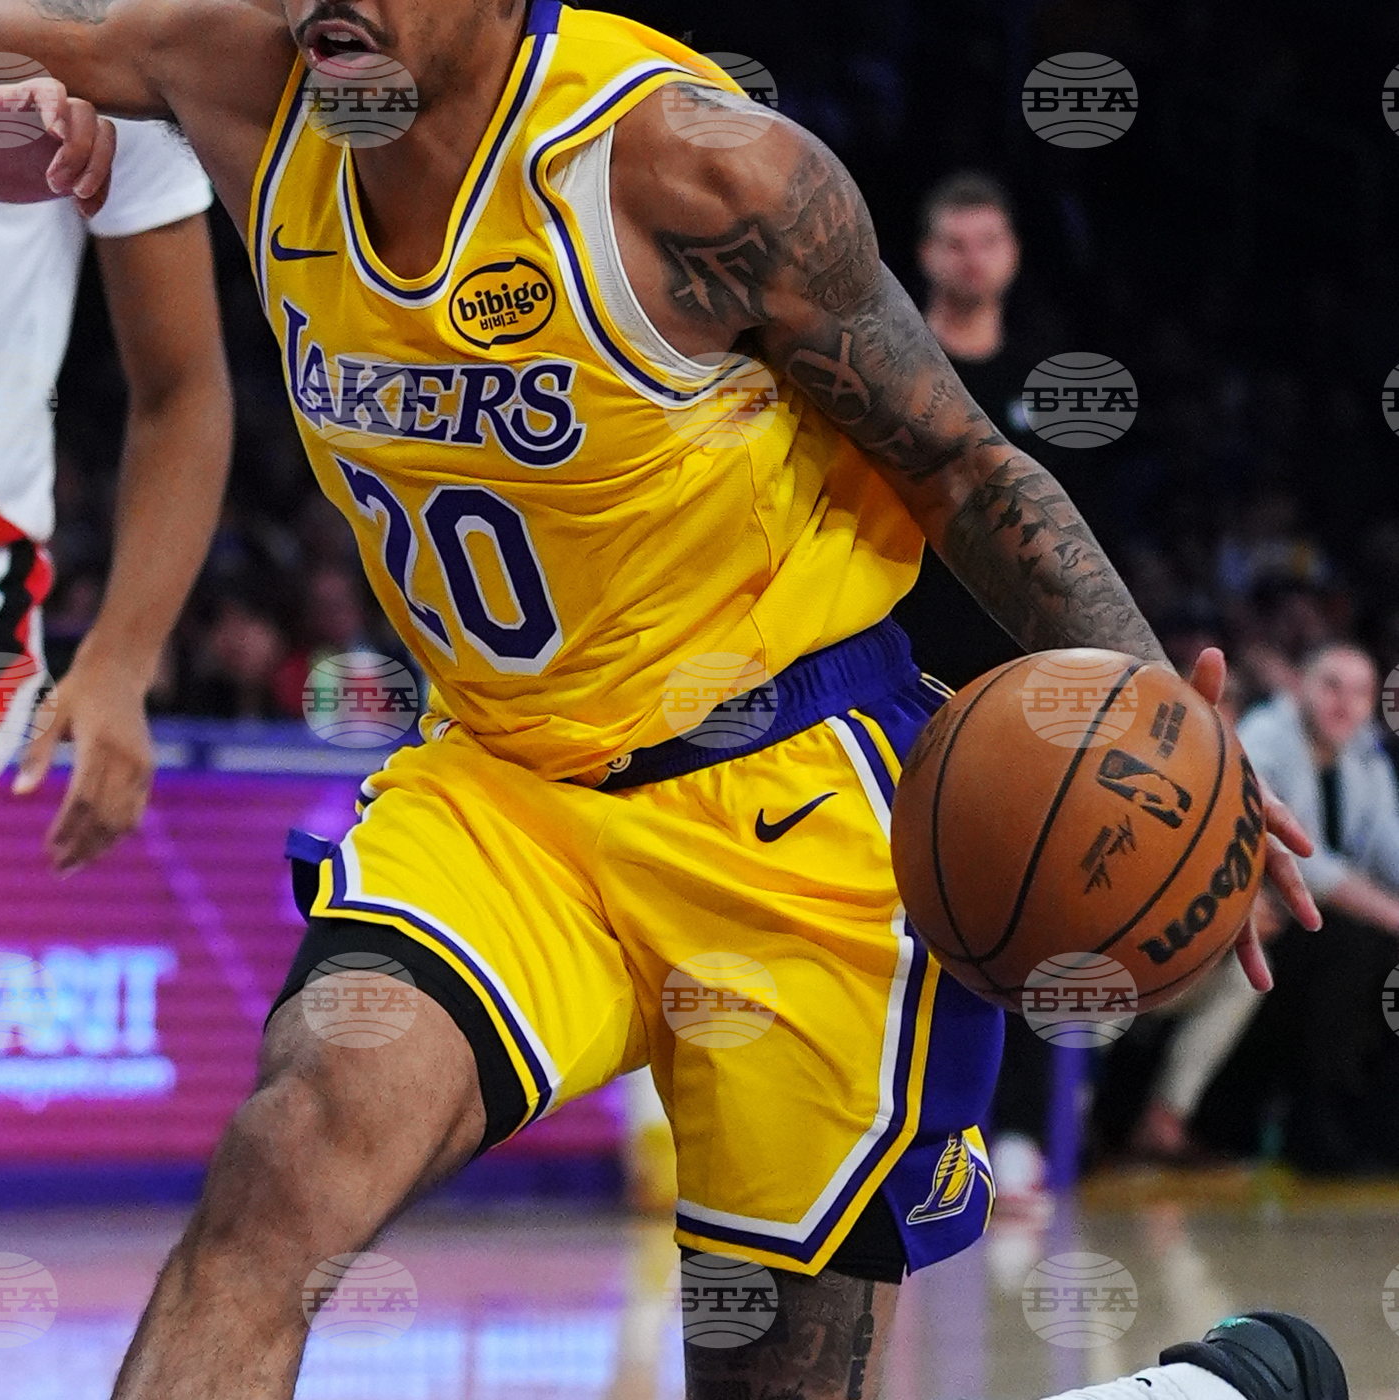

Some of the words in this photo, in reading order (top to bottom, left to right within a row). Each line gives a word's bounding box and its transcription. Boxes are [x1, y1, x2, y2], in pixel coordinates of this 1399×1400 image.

[457, 281, 549, 322] bibigo
[479, 310, 519, 331] 비비고
[281, 298, 587, 469] LAKERS
[331, 451, 565, 678] 20
